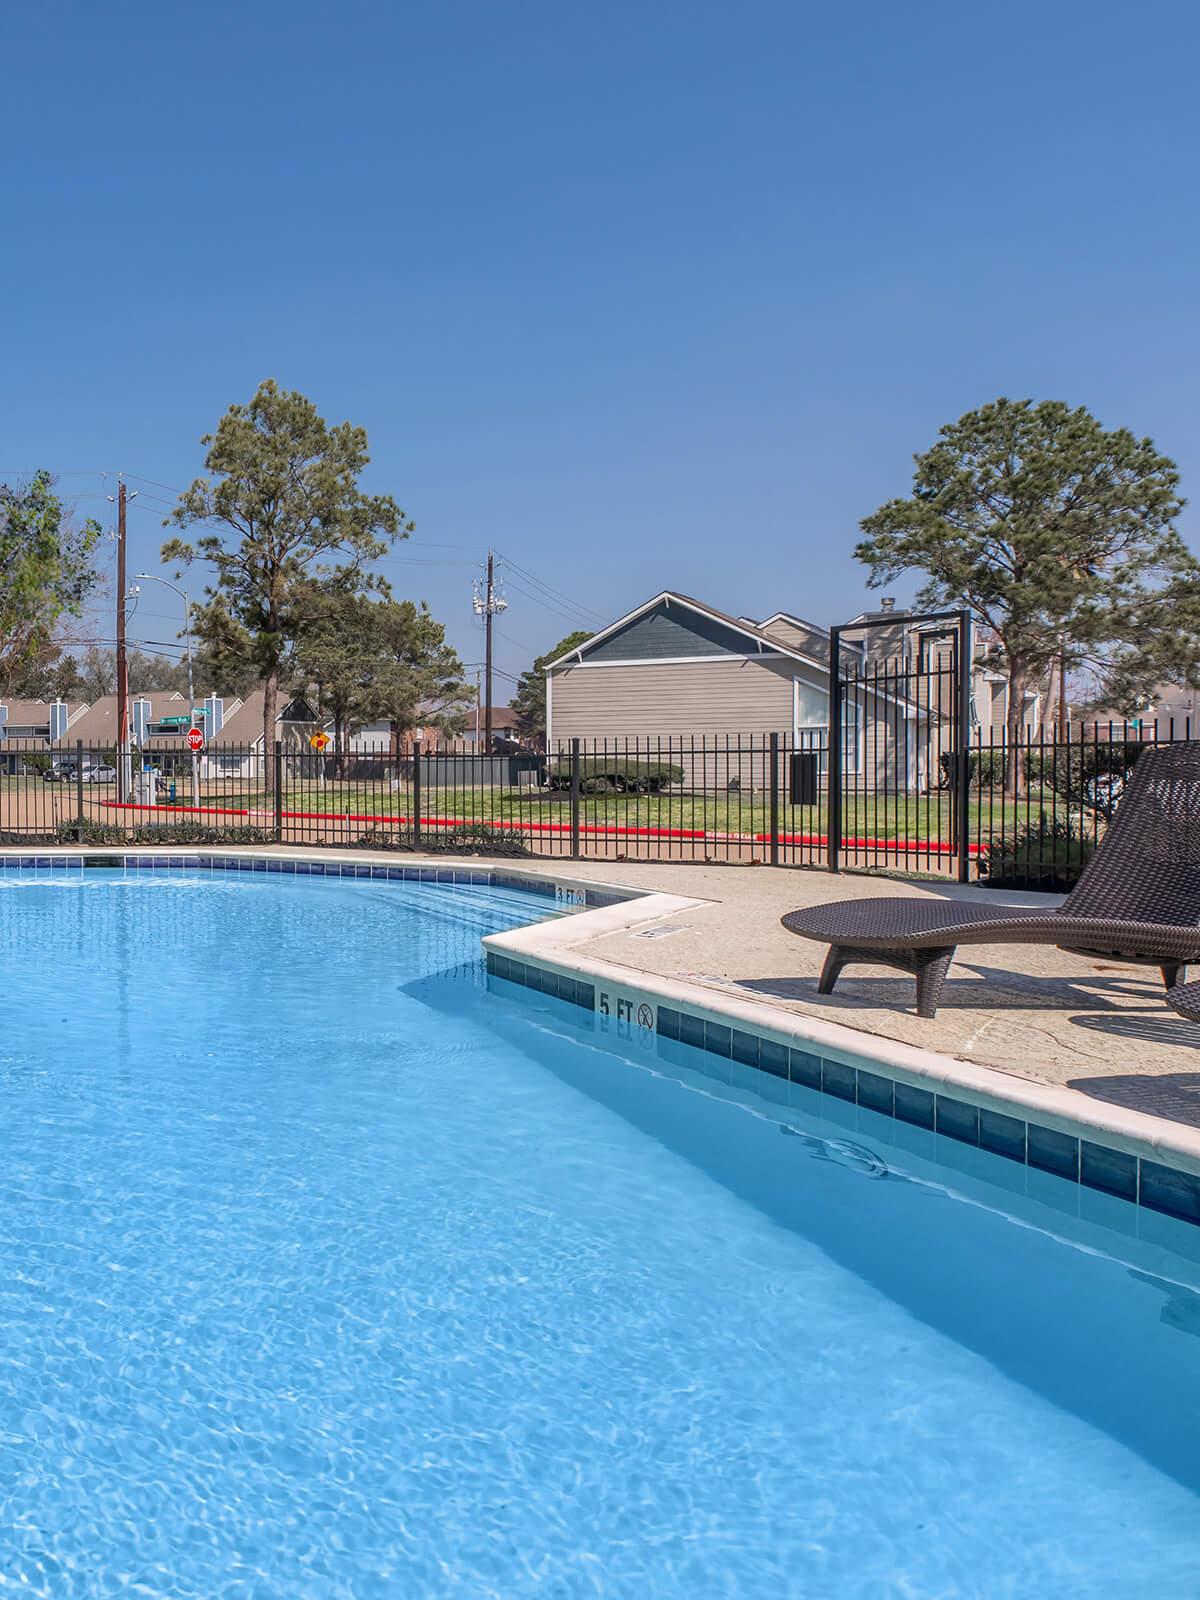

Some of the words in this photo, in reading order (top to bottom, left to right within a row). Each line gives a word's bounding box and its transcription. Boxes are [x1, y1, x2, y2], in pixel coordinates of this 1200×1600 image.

[188, 735, 203, 744] STOP
[557, 887, 563, 901] 3
[566, 889, 575, 904] FT
[600, 992, 609, 1015] 5
[617, 998, 634, 1023] FT
